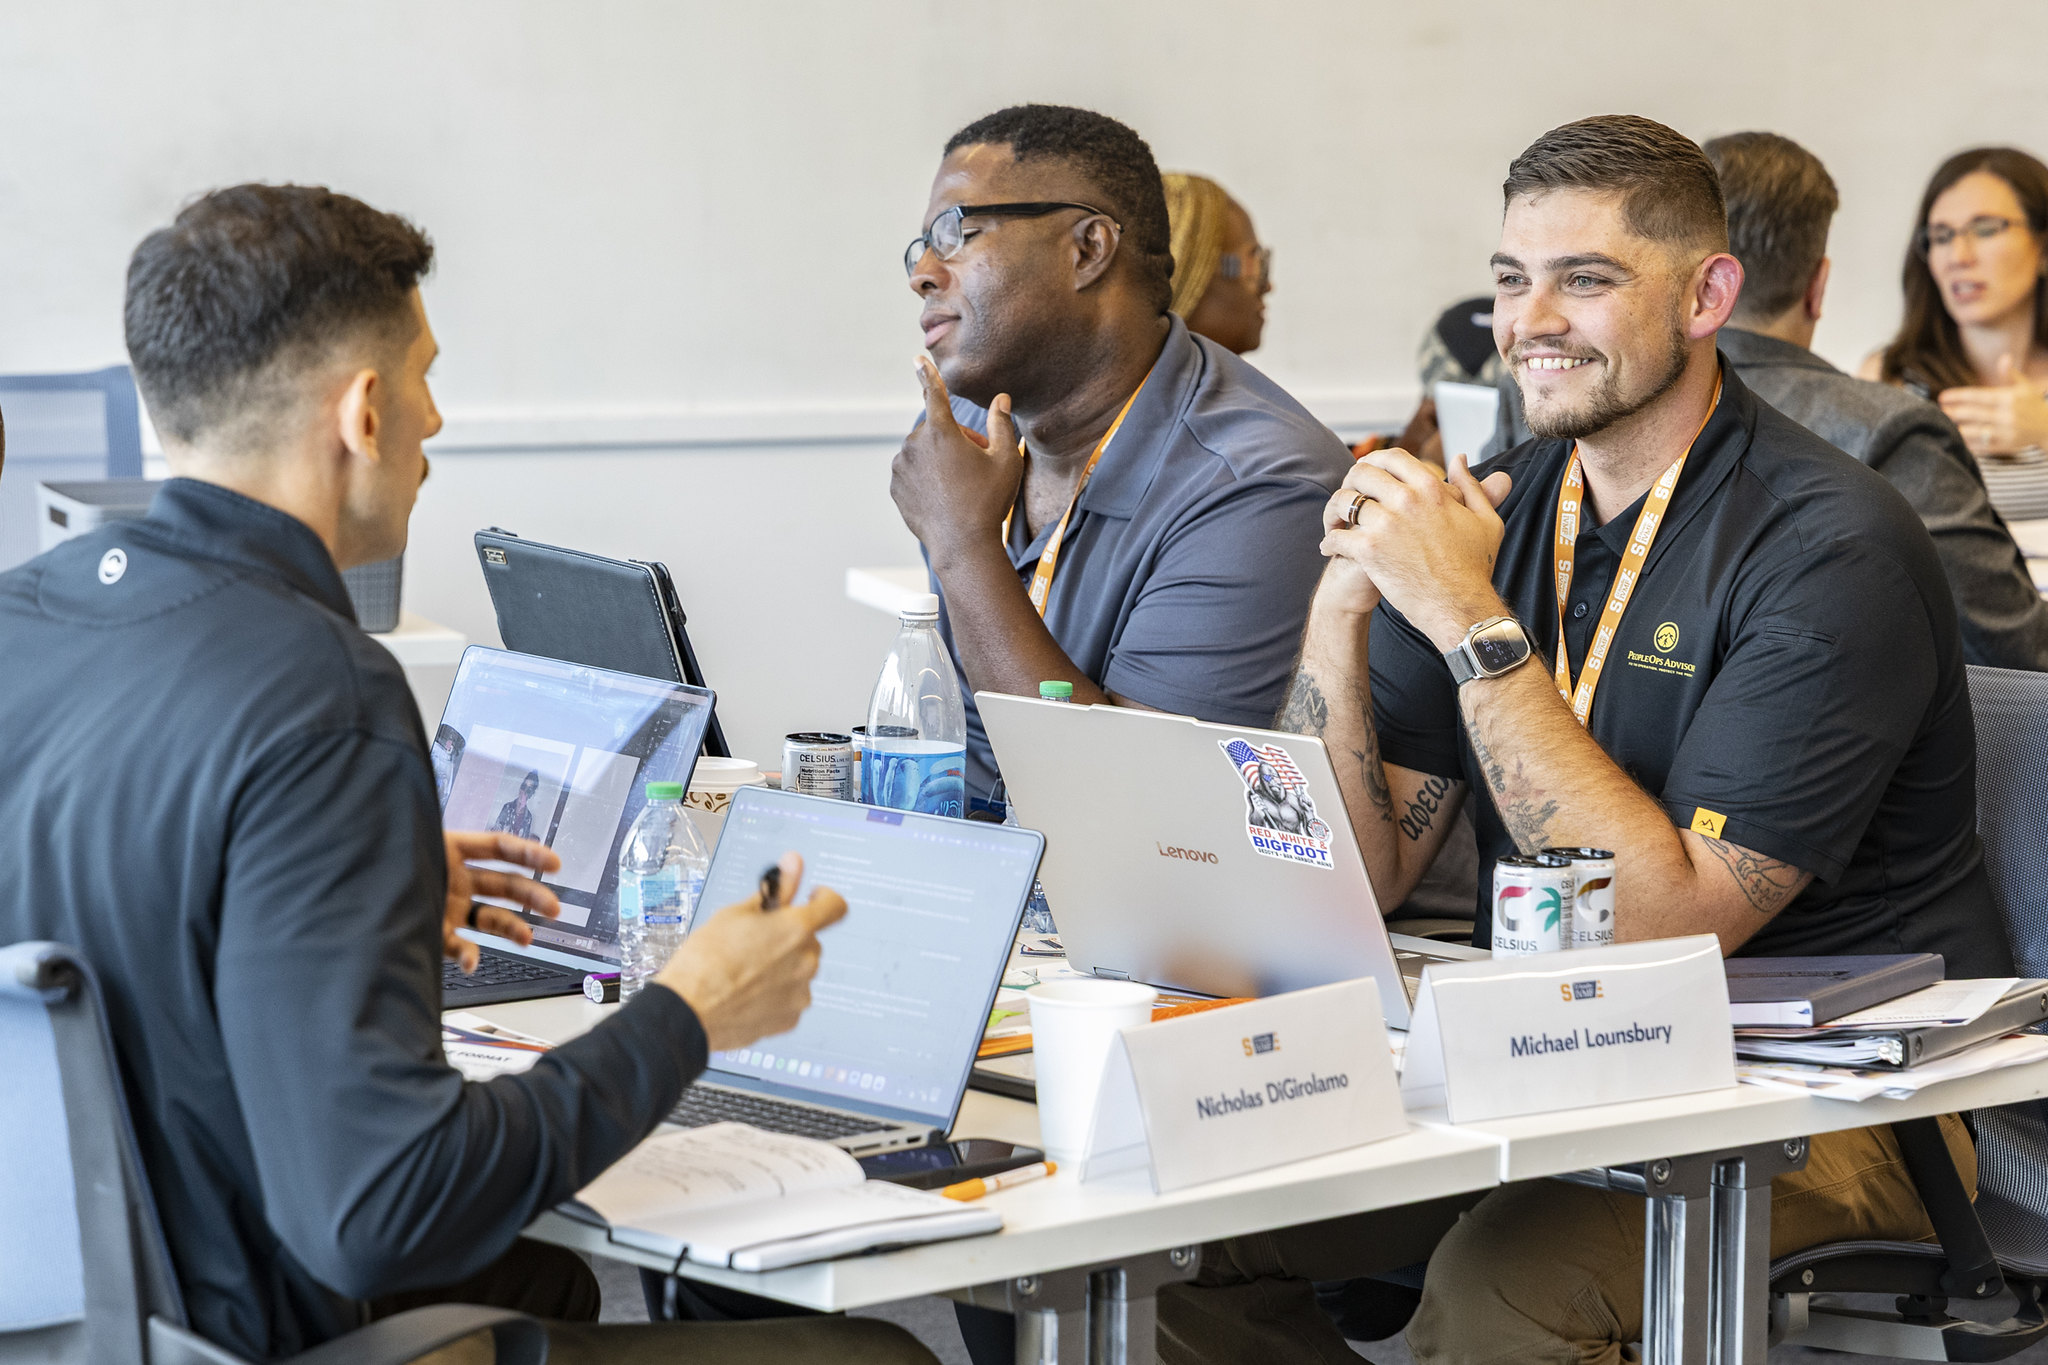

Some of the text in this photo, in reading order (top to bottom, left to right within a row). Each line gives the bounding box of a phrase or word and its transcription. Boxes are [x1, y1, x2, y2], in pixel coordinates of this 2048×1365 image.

[800, 753, 836, 763] CELSIUS
[1249, 826, 1327, 850] RED, WHITE &
[1252, 836, 1327, 860] BIGFOOT
[1156, 841, 1219, 864] Lenovo
[1572, 928, 1614, 942] CELSIUS
[1510, 1022, 1672, 1057] Michael Lounsbury
[457, 1051, 512, 1062] FORMAT
[1196, 1072, 1349, 1120] Nicholas DiGirolamo
